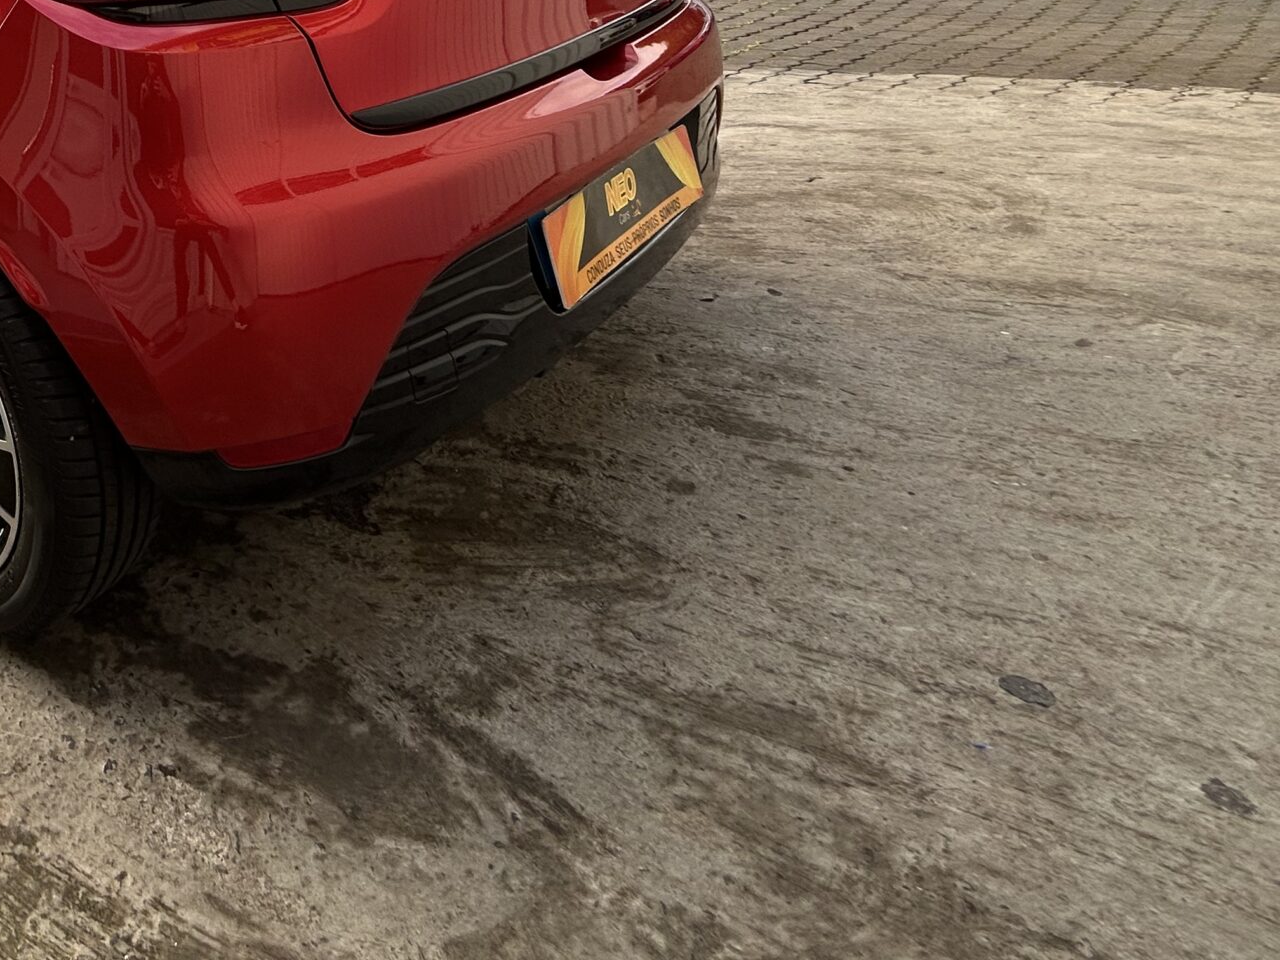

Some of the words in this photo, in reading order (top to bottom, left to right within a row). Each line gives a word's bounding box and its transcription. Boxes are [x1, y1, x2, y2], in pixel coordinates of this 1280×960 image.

[604, 167, 637, 217] NEO
[586, 251, 616, 284] CONDUZA
[614, 236, 633, 259] SEUS
